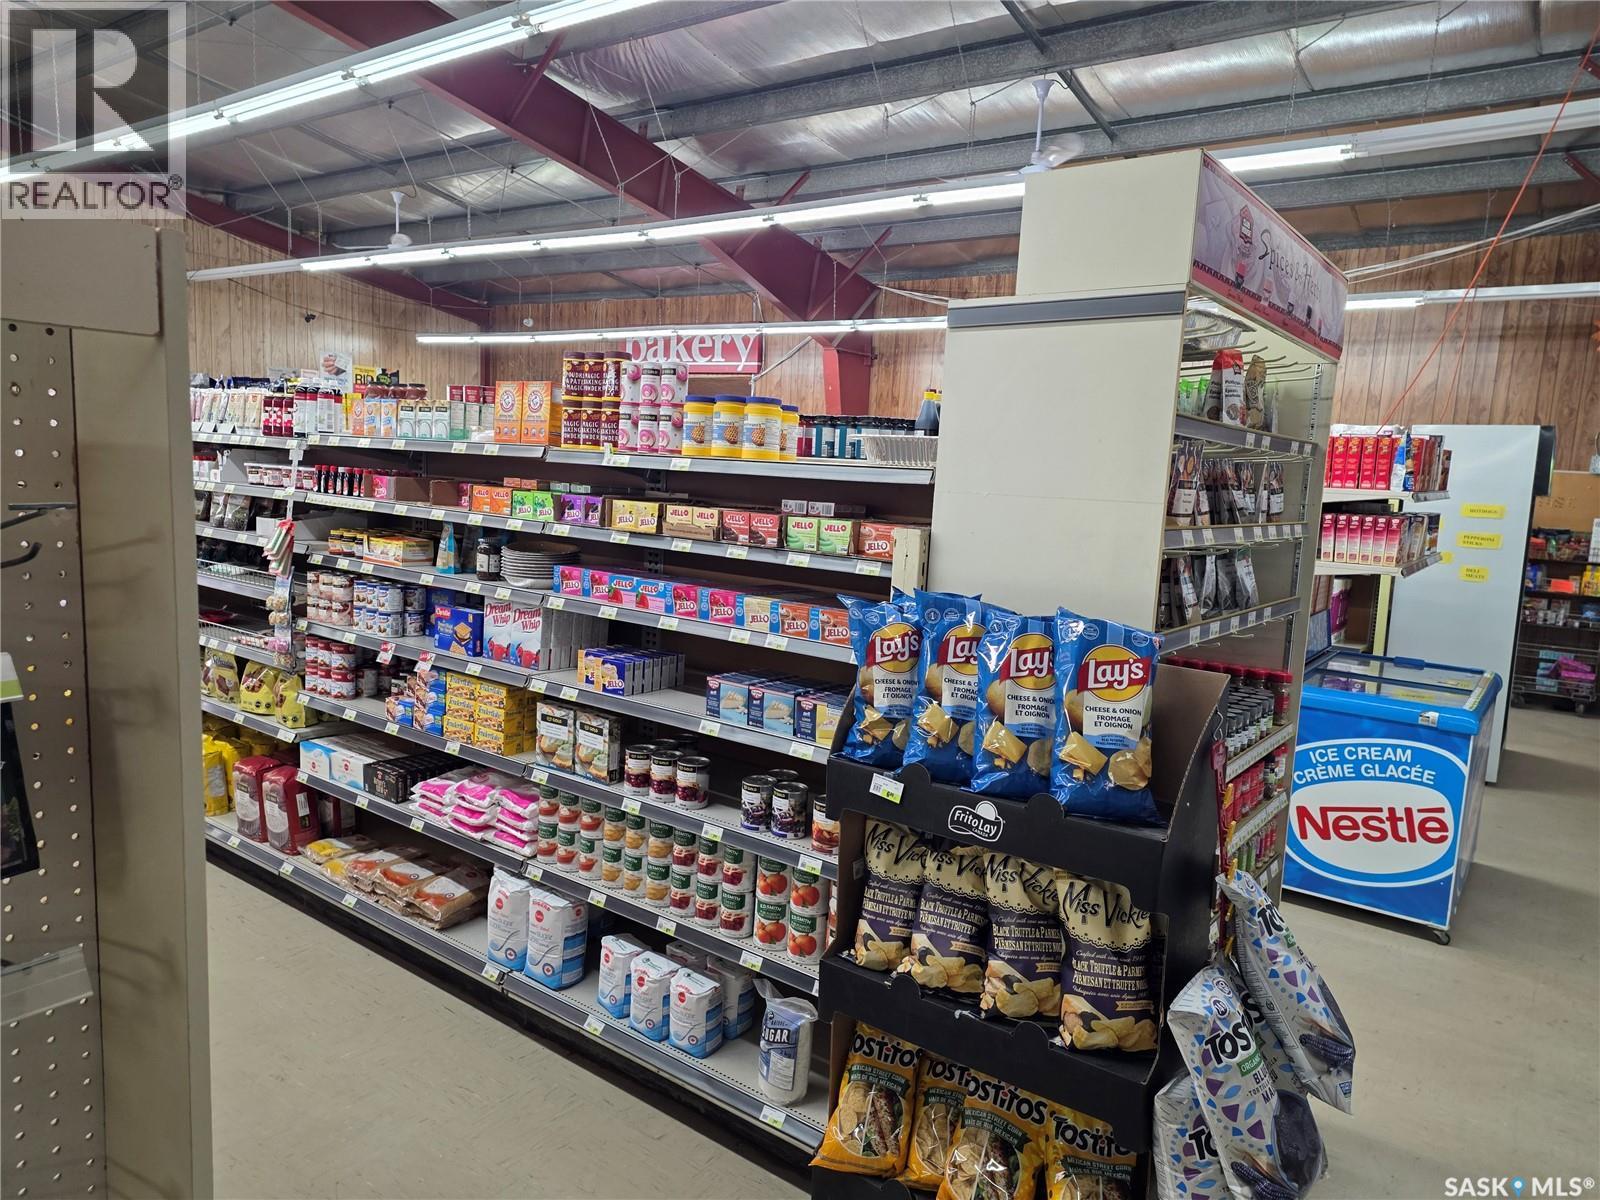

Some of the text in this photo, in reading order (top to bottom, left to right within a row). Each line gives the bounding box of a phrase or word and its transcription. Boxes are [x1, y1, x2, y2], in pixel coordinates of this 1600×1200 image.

[626, 333, 757, 372] bakery
[492, 614, 511, 626] Whip
[521, 620, 541, 631] Whip
[875, 631, 919, 663] Lay's
[944, 677, 966, 686] CHEESE
[1088, 659, 1144, 690] Lay's
[1007, 694, 1031, 702] CHEESE
[1017, 704, 1048, 712] FROMAGE
[1025, 710, 1050, 719] OIGNON
[1085, 705, 1111, 713] CHEESE
[1119, 708, 1142, 716] ONION
[1097, 715, 1131, 723] FROMAGE
[1104, 722, 1133, 730] OIGNON
[1309, 746, 1412, 764] ICE CREAM
[1293, 763, 1436, 785] CRÈME GLACÉE
[1296, 805, 1450, 844] Nestlé
[864, 823, 895, 858] Miss
[987, 854, 1018, 884] Miss
[1063, 882, 1101, 921] Miss
[993, 924, 1010, 937] BLACK
[1010, 926, 1035, 938] TRUFFLE
[995, 938, 1023, 950] PARMESAN
[1030, 941, 1051, 952] TRUFFE
[1090, 961, 1116, 976] TRUFFLE
[1073, 971, 1103, 987] PARMESAN
[1111, 977, 1134, 990] TRUFFE
[762, 1025, 789, 1043] SUGAR
[872, 1068, 891, 1079] STREET
[987, 1114, 1006, 1128] STREET
[1007, 1122, 1023, 1136] CORN
